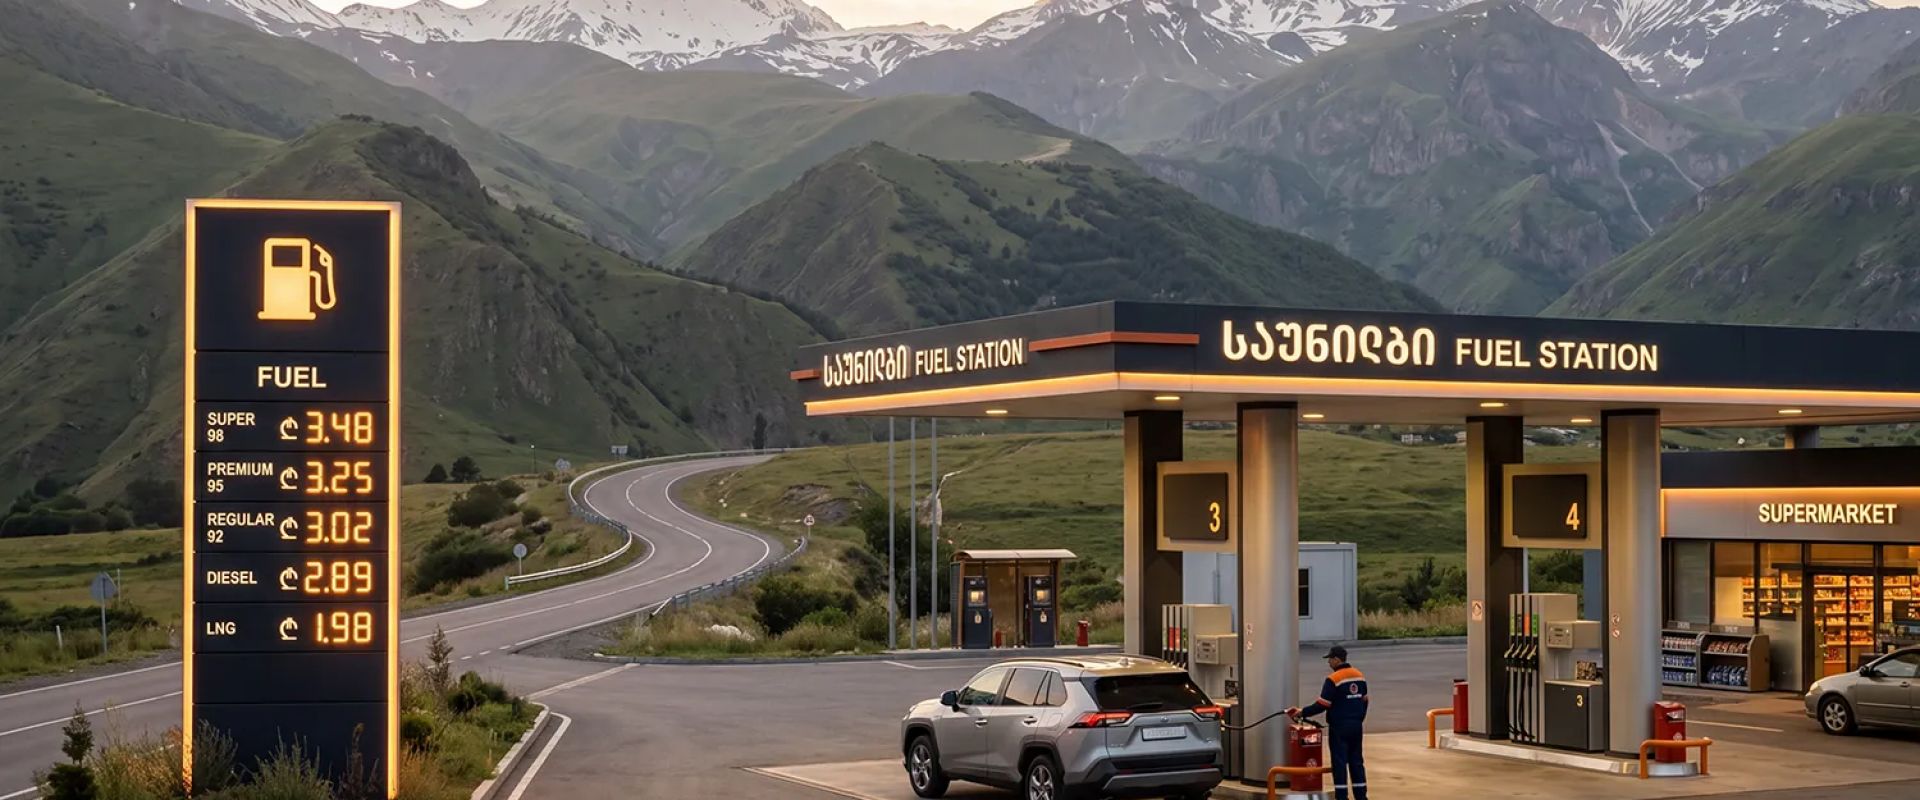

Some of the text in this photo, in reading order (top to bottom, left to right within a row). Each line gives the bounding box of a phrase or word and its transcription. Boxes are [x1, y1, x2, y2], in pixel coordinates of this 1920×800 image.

[915, 347, 953, 376] FUEL
[956, 337, 1024, 372] STATION
[1455, 338, 1531, 366] FUEL
[1538, 342, 1658, 372] STATION
[257, 365, 327, 388] FUEL
[207, 411, 256, 426] SUPER
[306, 411, 373, 444] 3.48
[207, 428, 225, 443] 98
[207, 462, 274, 476] PREMIUM
[306, 461, 373, 494] 3.25
[207, 479, 224, 493] 95
[207, 512, 275, 526] REGULAR
[1209, 501, 1221, 533] 3
[1565, 502, 1580, 531] 4
[1757, 503, 1898, 524] SUPERMARKET
[207, 529, 224, 544] 92
[306, 511, 373, 544] 3.02
[206, 570, 258, 585] DIESEL
[304, 561, 373, 594] 2.89
[206, 621, 236, 635] LNG
[315, 611, 373, 644] 1.98
[1576, 694, 1583, 707] 3
